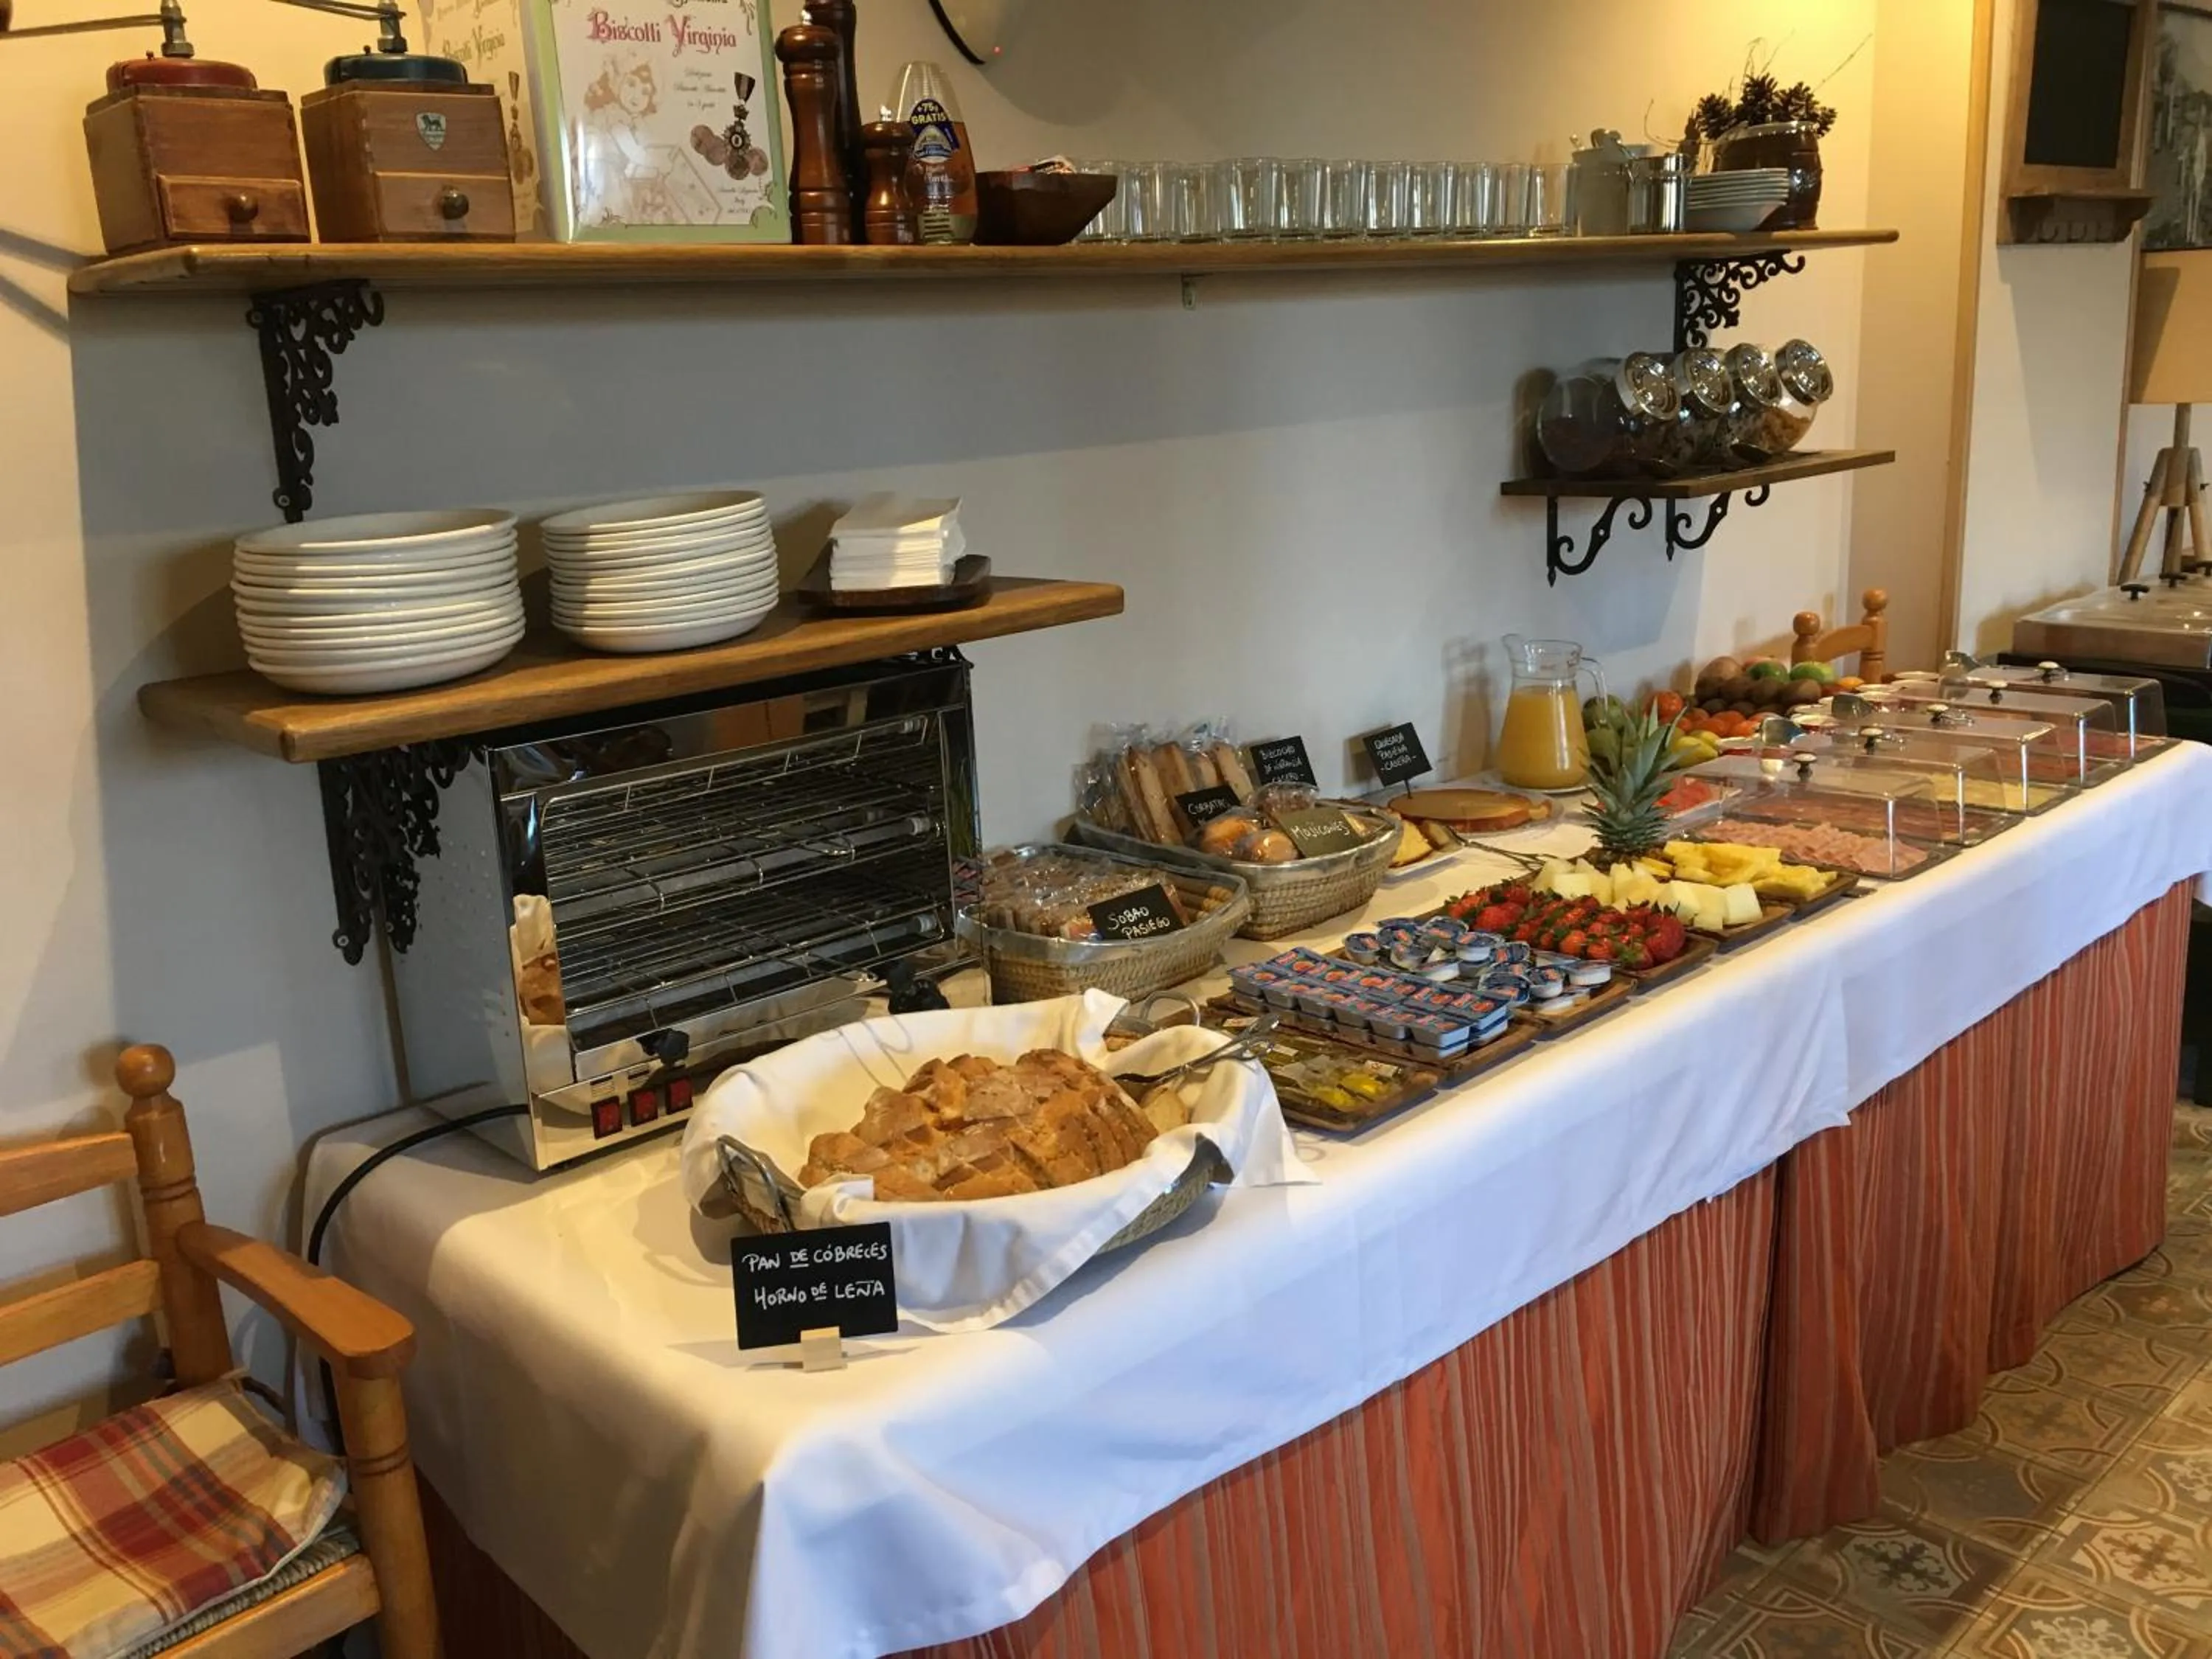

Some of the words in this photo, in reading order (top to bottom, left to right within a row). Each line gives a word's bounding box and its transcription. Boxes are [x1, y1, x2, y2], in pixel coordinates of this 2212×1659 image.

[666, 14, 737, 58] Virginia
[911, 112, 946, 125] GRATIS
[1108, 906, 1150, 931] SOBAO
[1121, 917, 1171, 940] PASIEGO
[742, 1253, 781, 1273] PAN
[790, 1248, 810, 1267] DE
[754, 1286, 807, 1310] HORNO
[811, 1282, 827, 1301] DE
